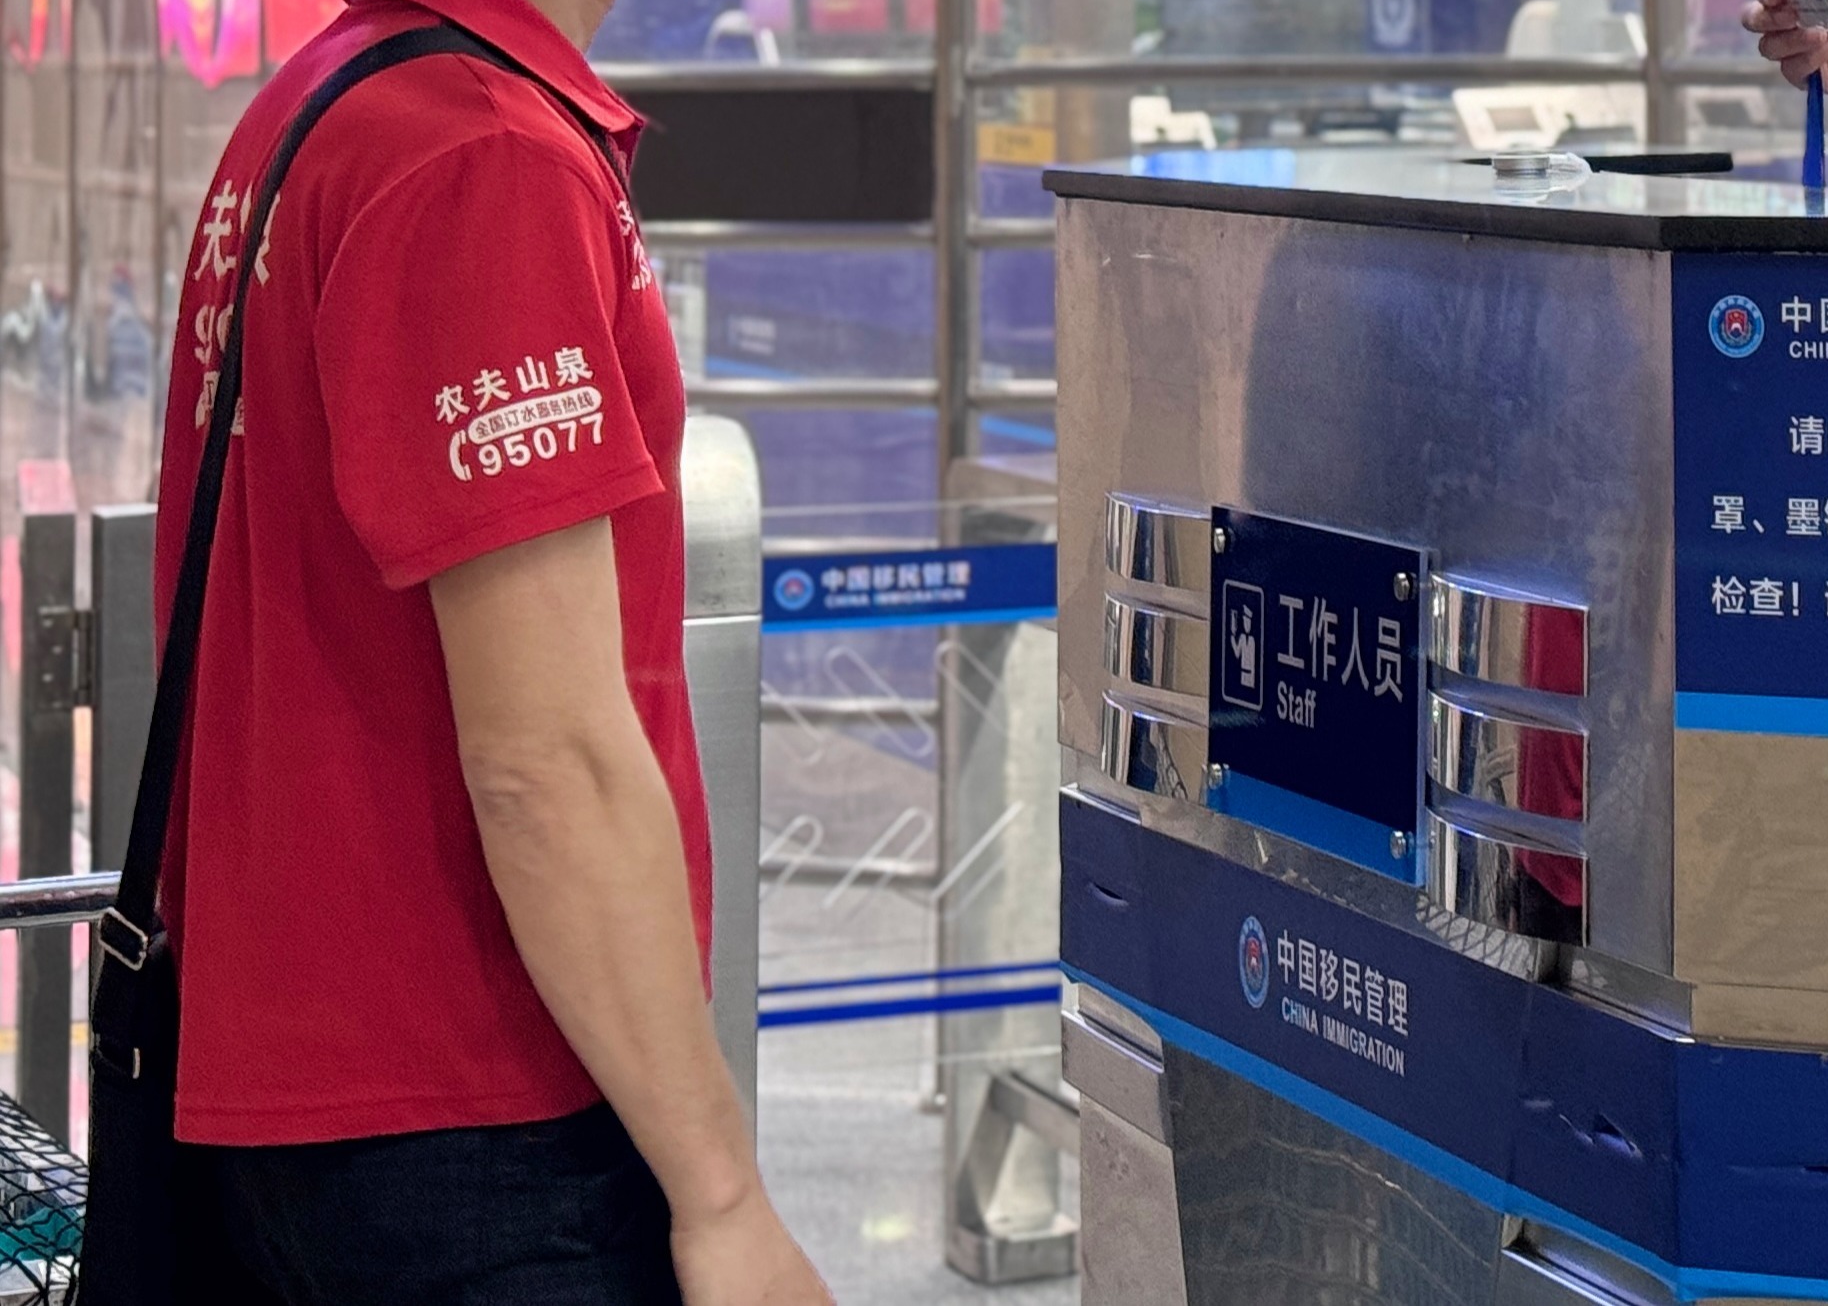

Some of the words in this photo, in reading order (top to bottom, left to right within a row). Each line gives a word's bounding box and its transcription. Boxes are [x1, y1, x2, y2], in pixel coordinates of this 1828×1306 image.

[434, 346, 594, 425] 农夫山泉
[475, 390, 595, 440] 全国订水服务热线
[478, 411, 604, 477] 95077
[1277, 592, 1403, 704] 工作人员
[1276, 680, 1317, 729] Staff
[1276, 929, 1410, 1037] 中国移民管理
[1281, 996, 1319, 1036] CHINA
[1322, 1015, 1406, 1078] IMMIGRATION
